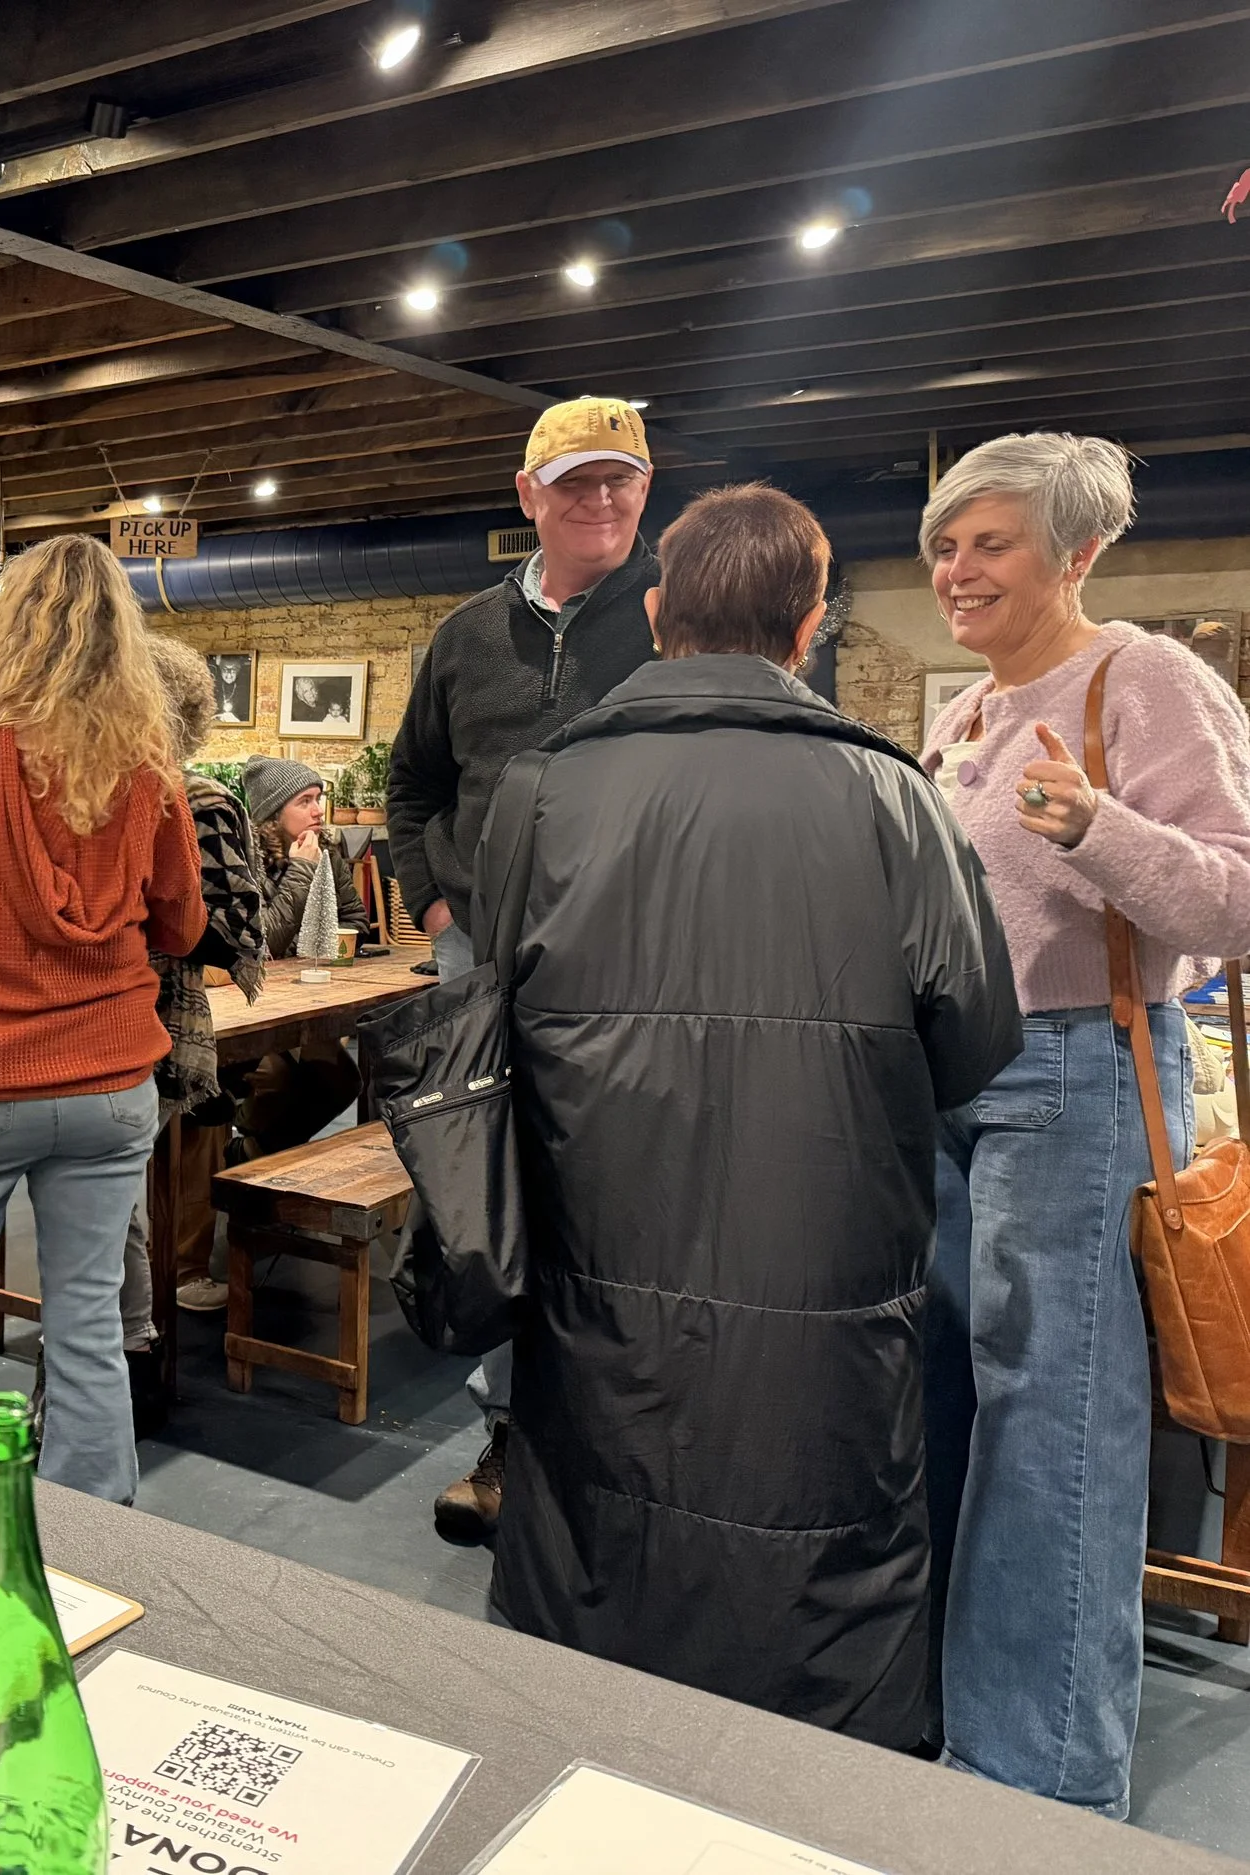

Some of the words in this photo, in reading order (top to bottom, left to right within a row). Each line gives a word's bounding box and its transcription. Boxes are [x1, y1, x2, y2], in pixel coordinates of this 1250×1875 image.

[119, 521, 166, 537] PICK
[169, 521, 192, 537] UP
[129, 539, 179, 556] HERE
[137, 1684, 177, 1701] Council
[179, 1697, 202, 1708] Arts
[202, 1704, 252, 1725] Watauga
[265, 1714, 309, 1732] THANK
[268, 1724, 309, 1742] written
[311, 1738, 327, 1749] be
[328, 1743, 351, 1754] can
[352, 1750, 396, 1769] Checks
[107, 1794, 139, 1811] Art
[109, 1784, 178, 1813] County!
[171, 1792, 217, 1813] your
[141, 1806, 171, 1824] the
[214, 1808, 265, 1829] need
[182, 1809, 266, 1845] Watauga
[267, 1825, 299, 1844] We
[176, 1819, 283, 1863] Strengthen
